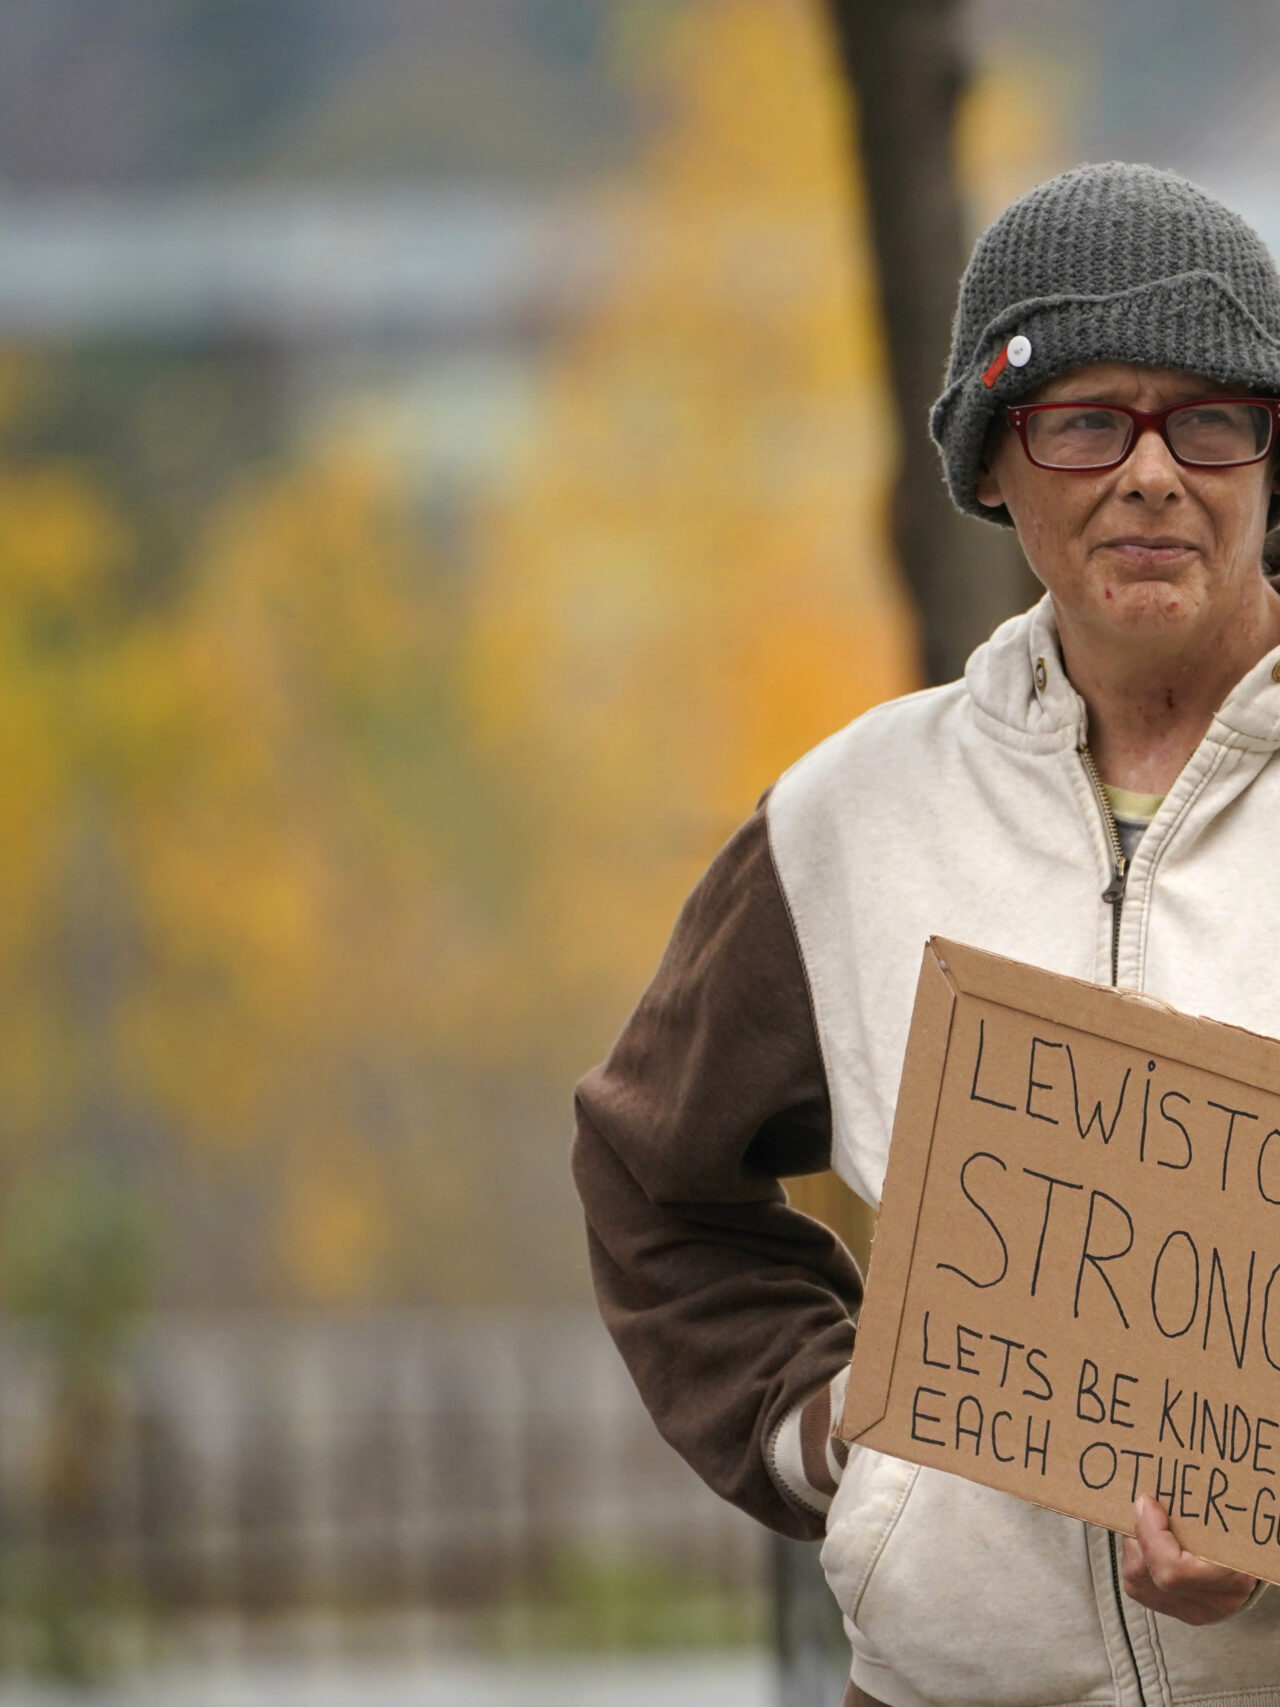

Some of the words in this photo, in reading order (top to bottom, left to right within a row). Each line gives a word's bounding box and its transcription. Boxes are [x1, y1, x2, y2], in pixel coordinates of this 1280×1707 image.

[923, 1311, 1053, 1401] LETS
[1076, 1358, 1139, 1429] BE
[911, 1386, 1050, 1475] EACH
